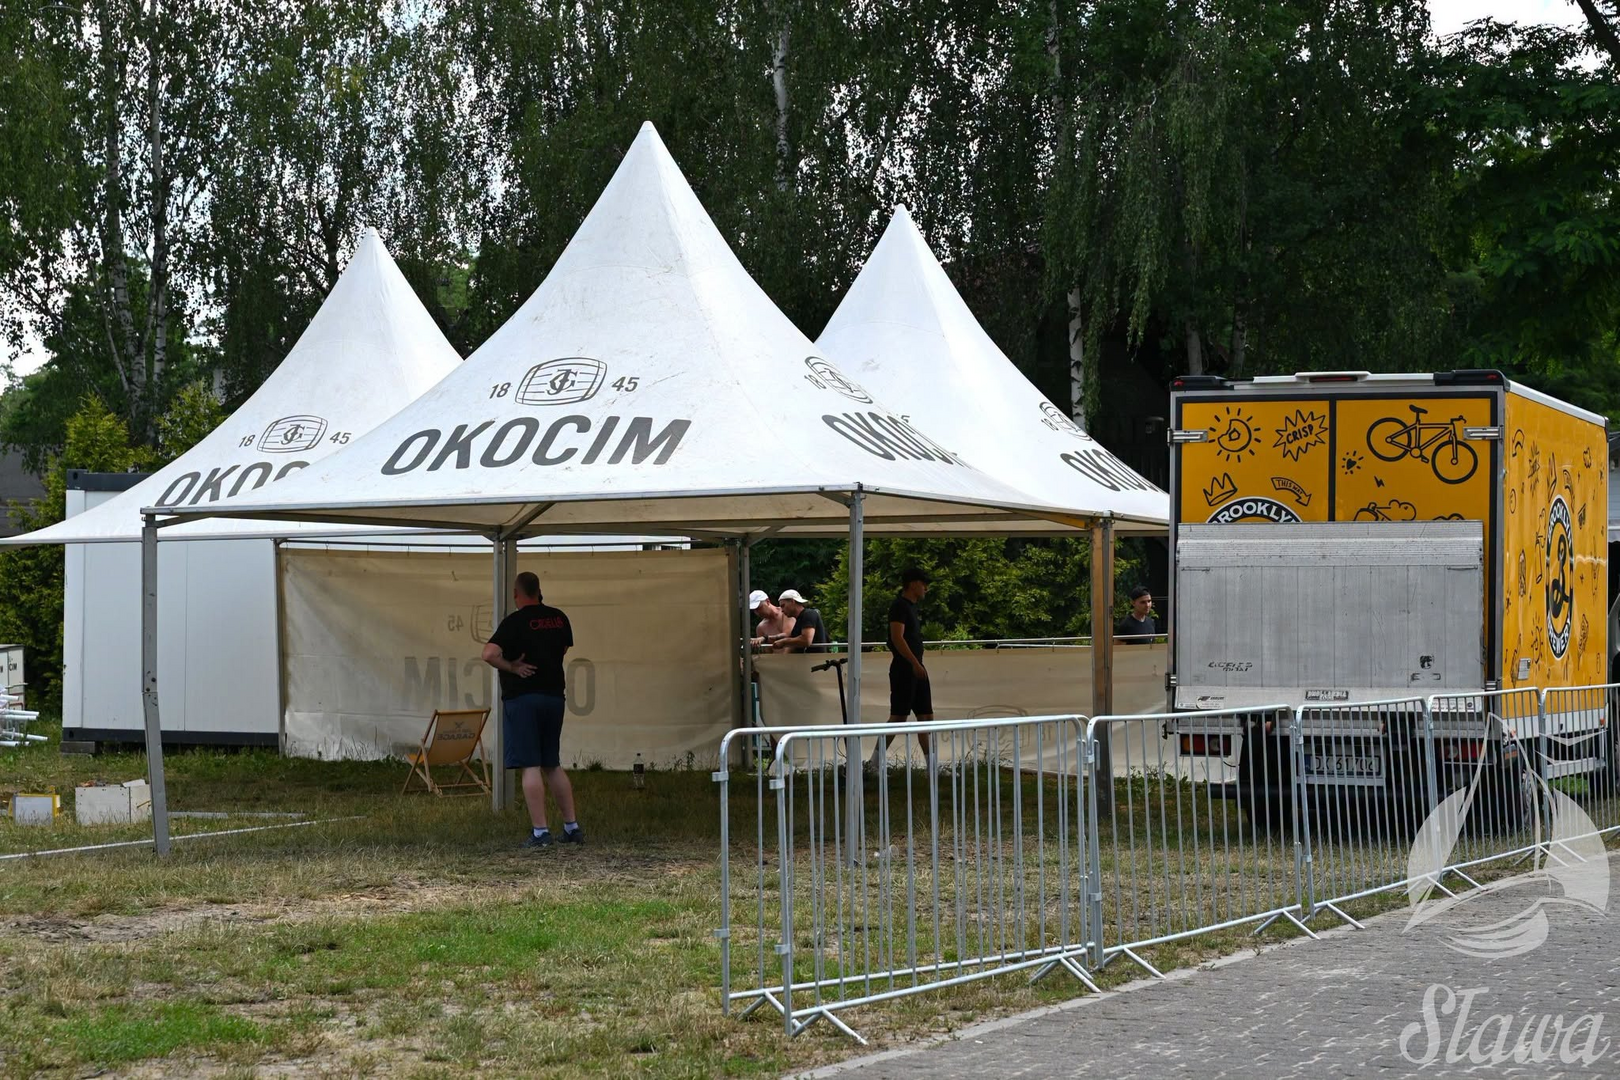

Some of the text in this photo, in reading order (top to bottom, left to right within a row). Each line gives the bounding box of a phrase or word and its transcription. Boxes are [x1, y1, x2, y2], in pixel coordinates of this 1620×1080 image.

[489, 375, 640, 400] 18 45
[804, 374, 827, 390] 18
[238, 430, 351, 449] 18 45
[1286, 424, 1314, 445] CRISP
[380, 415, 692, 476] OKOCIM
[1276, 480, 1292, 488] THIS
[1212, 502, 1298, 523] ROOKLY
